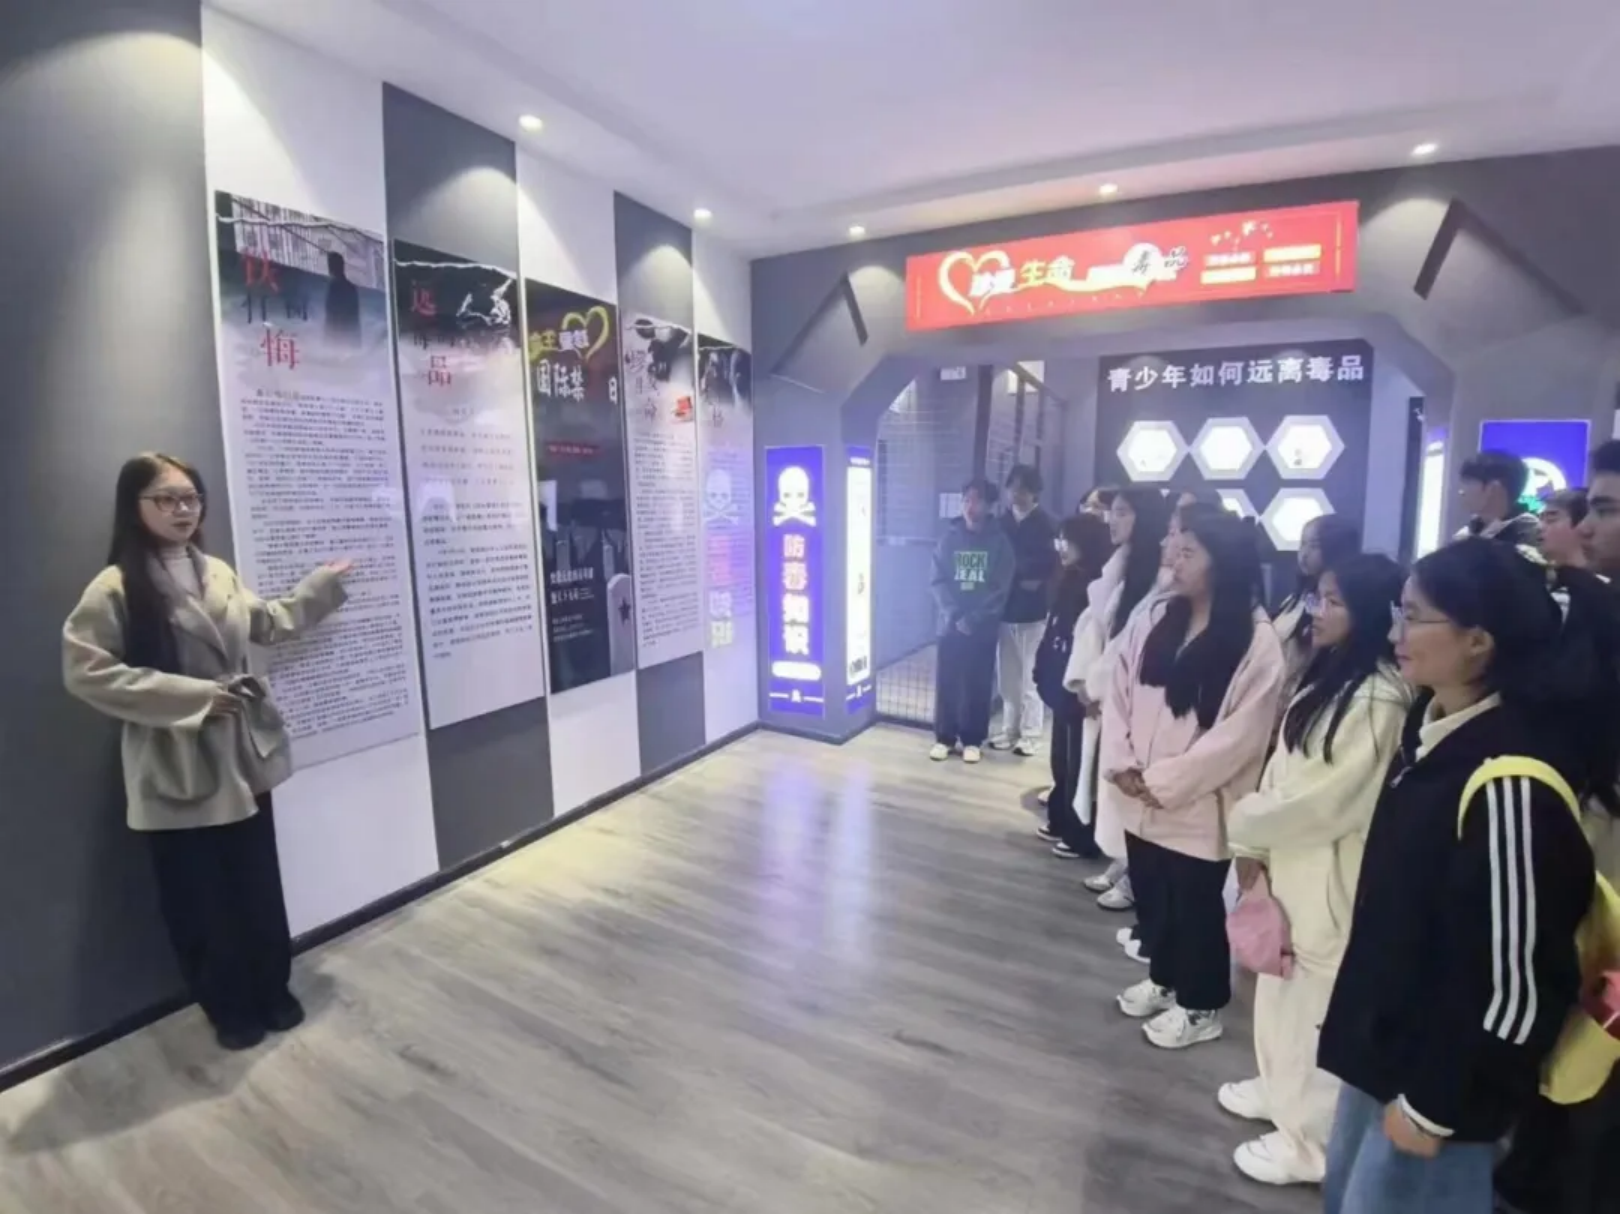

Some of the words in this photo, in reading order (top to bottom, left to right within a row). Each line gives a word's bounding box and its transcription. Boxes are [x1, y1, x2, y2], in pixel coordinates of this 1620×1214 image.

[1107, 355, 1364, 392] 青少年如何远离毒品
